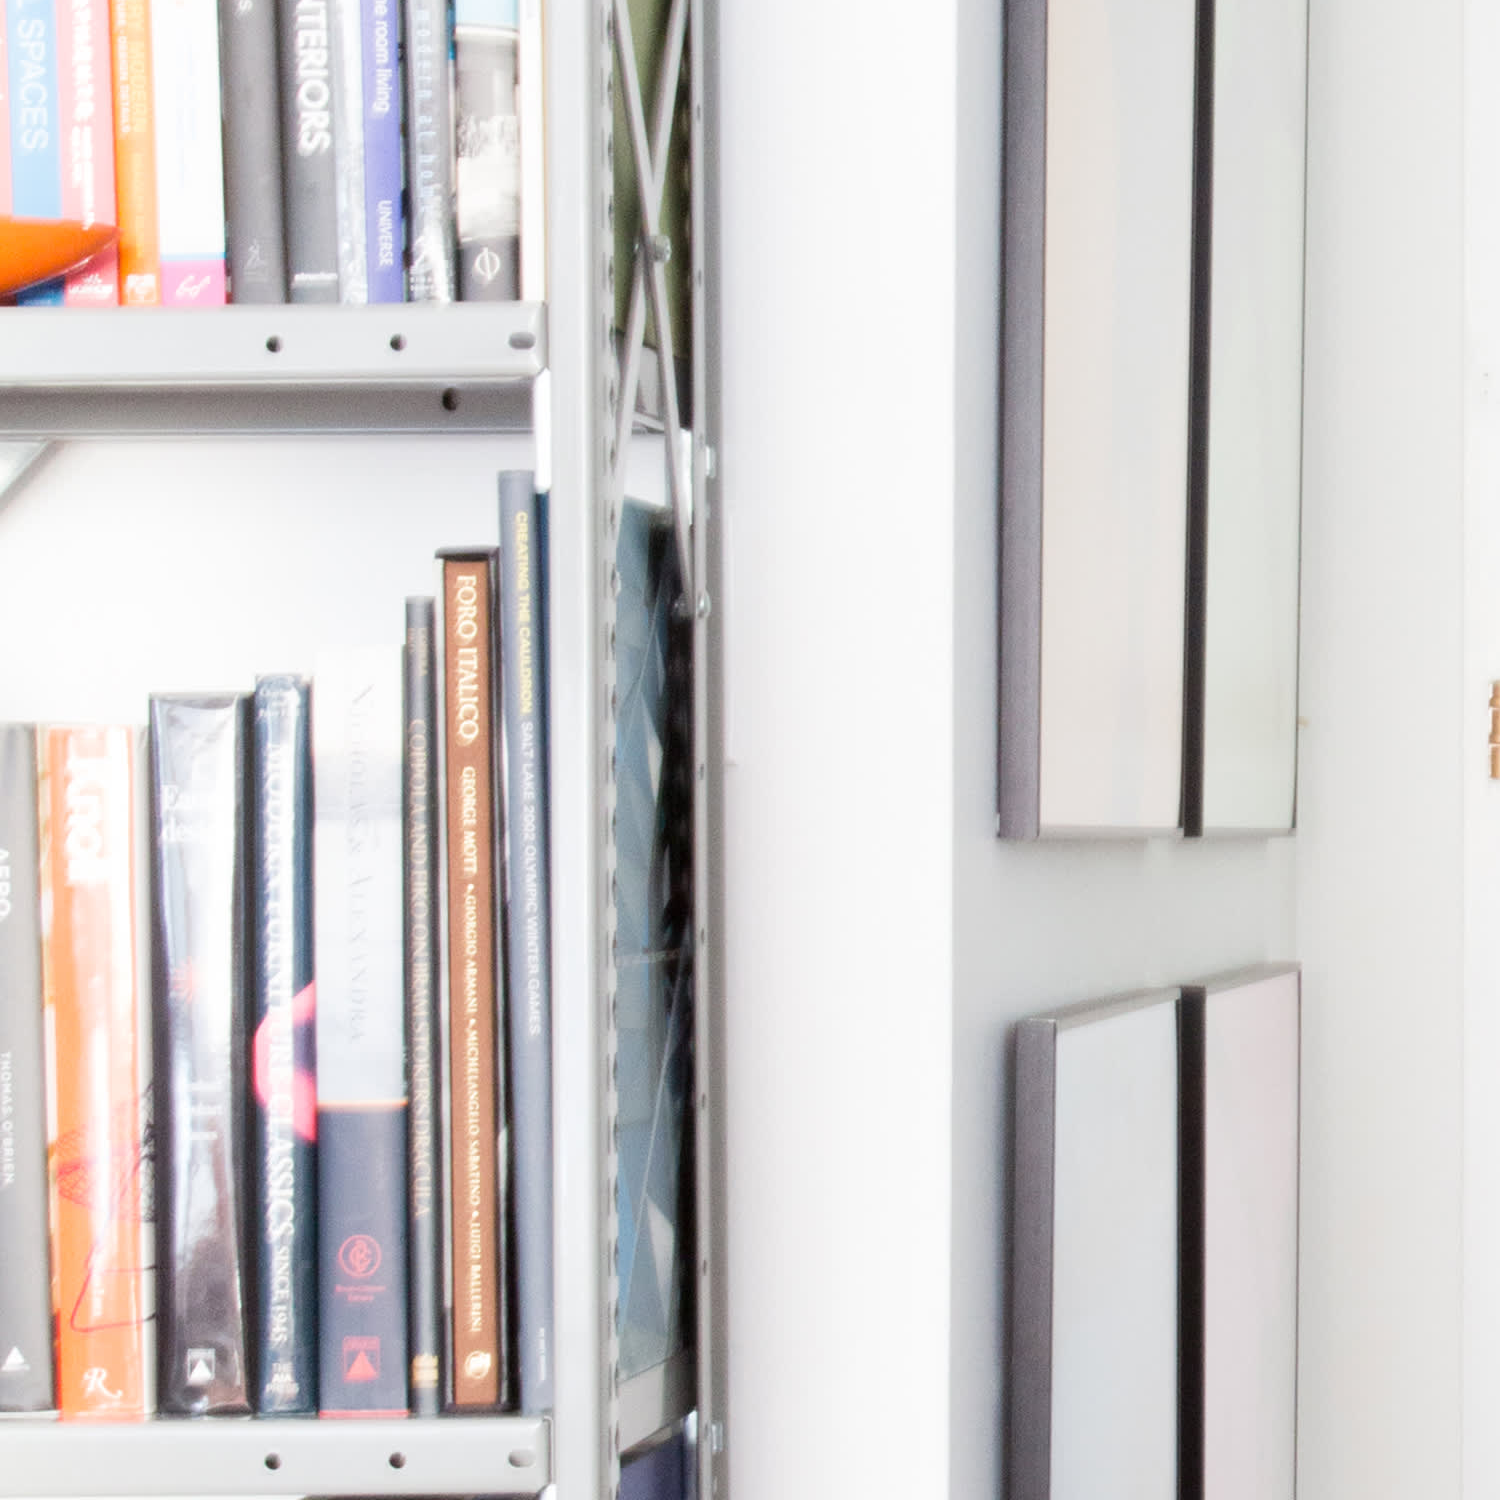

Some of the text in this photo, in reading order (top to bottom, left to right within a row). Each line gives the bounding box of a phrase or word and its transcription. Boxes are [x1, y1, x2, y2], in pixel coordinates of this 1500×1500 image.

[16, 19, 49, 152] SPACES
[129, 40, 149, 134] MODERN
[374, 20, 390, 64] room
[372, 67, 393, 115] living
[378, 199, 394, 268] UNIVERSE
[456, 574, 480, 743] FORO ITALICO
[408, 718, 428, 815] COPPOLA
[516, 511, 542, 1037] CREATING THE CAULDRON SALT LAKE 2002 OLYMPIC WINTER GAMES
[410, 820, 429, 865] AND
[462, 765, 483, 1333] GEORGE MOTT GIORGIO ARMANI MICHELANGELO SABATINO LUIGI BALLERINI
[1, 1051, 15, 1185] THOMAS O'BRIEN
[268, 1092, 295, 1243] CLASSICS
[414, 1118, 432, 1219] DRACULA
[272, 1244, 291, 1301] SINCE
[271, 1303, 290, 1347] 1945
